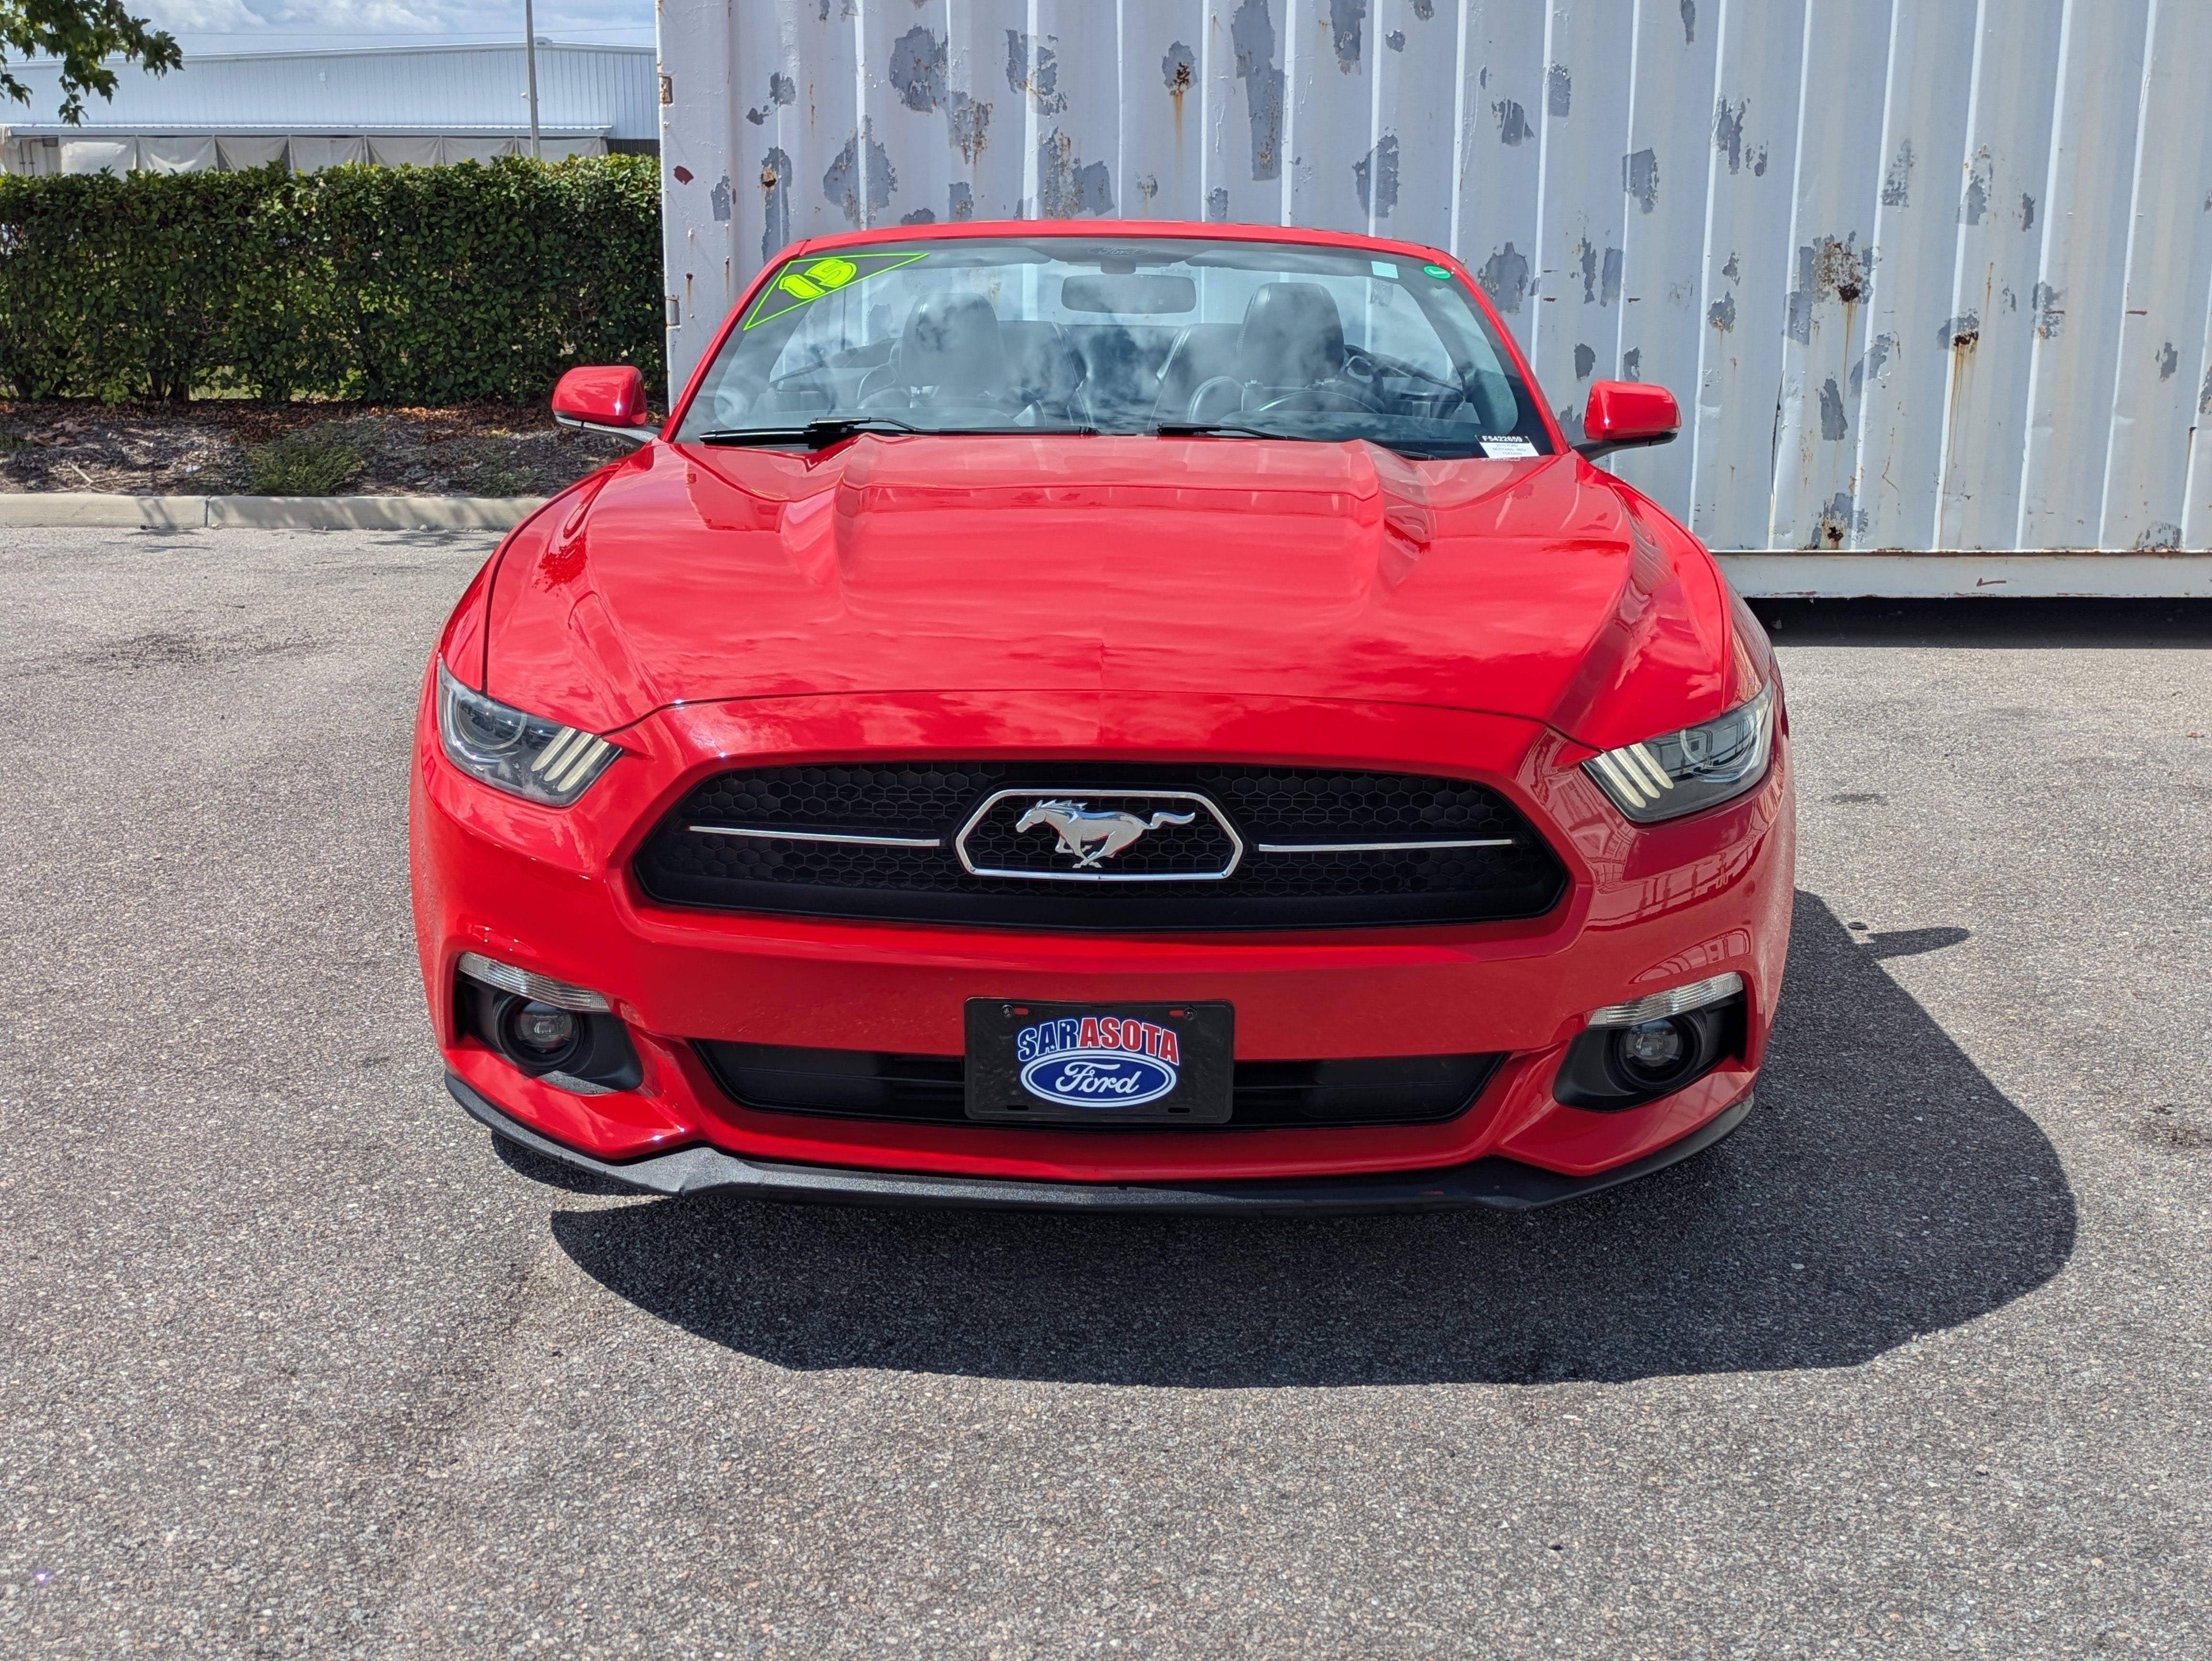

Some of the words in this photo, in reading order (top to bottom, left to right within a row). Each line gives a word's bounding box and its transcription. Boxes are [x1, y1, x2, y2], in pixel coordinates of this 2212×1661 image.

[1098, 247, 1139, 255] Ford
[779, 258, 857, 299] 15
[1018, 1017, 1180, 1066] SARASOTA
[1055, 1062, 1142, 1094] Ford
